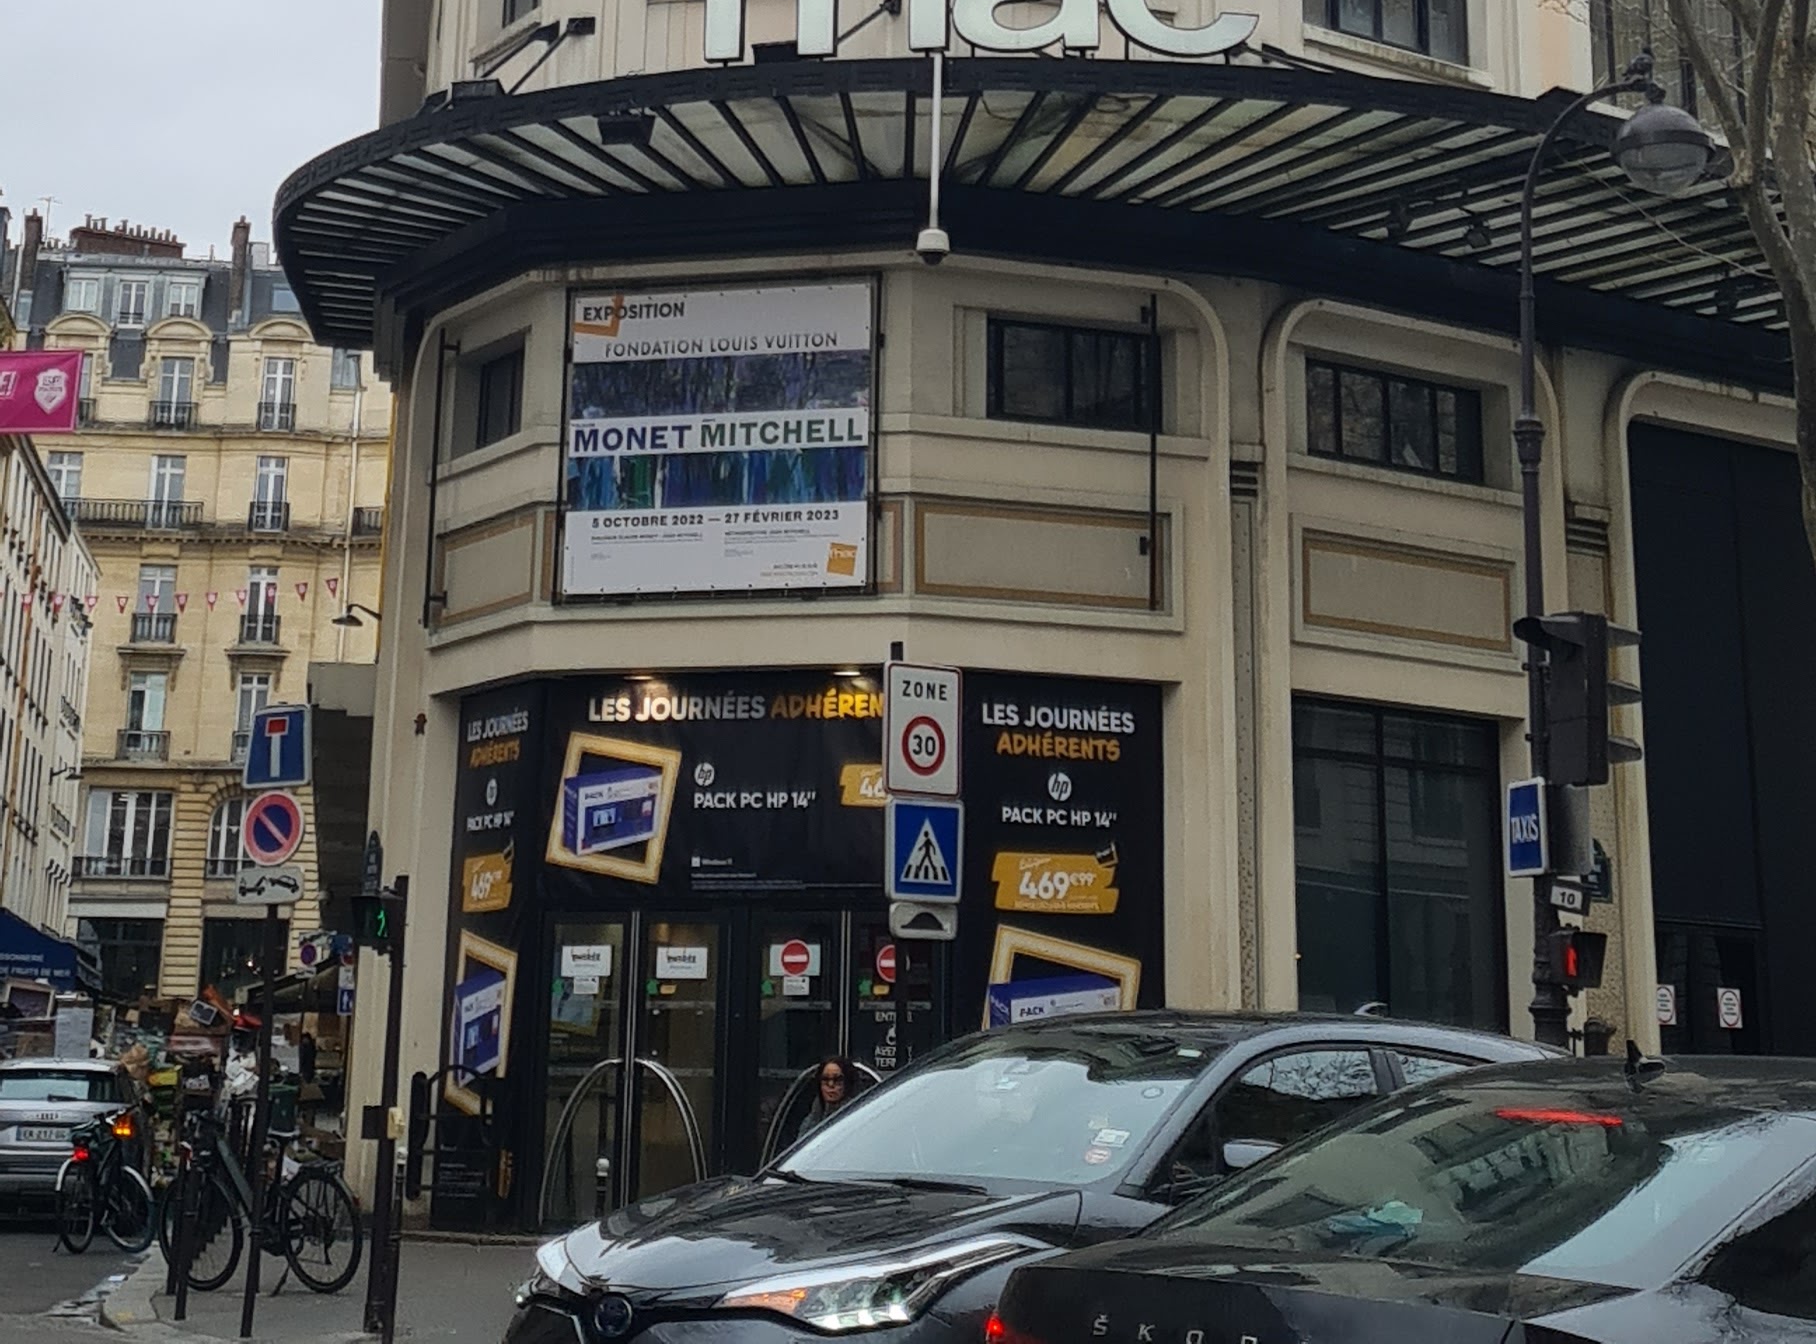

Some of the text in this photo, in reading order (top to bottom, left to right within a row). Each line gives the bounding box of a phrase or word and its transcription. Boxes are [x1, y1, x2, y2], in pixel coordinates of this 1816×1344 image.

[583, 301, 685, 322] EXPOSITION
[605, 331, 838, 358] FONDATION LOUIS VUITTON
[574, 417, 863, 453] MONET MITCHELL
[602, 515, 668, 528] OCTOBRE
[671, 514, 704, 526] 2022
[724, 512, 740, 524] 27
[743, 509, 803, 523] FÉVRIER
[806, 509, 840, 521] 2023
[902, 680, 948, 702] ZONE
[588, 687, 886, 723] LES JOURNÉES ADHÉREN
[982, 702, 1136, 734] LES JOURNÉES
[911, 734, 937, 757] 30
[996, 731, 1121, 762] ADHÉRENTS
[1048, 772, 1072, 802] hp
[693, 791, 737, 809] PACK
[740, 791, 764, 809] PC
[766, 791, 789, 809] HP
[1001, 806, 1044, 825] PACK
[1046, 809, 1068, 826] PC
[1070, 810, 1092, 827] HP
[1510, 813, 1539, 844] TAXIS
[1559, 890, 1576, 906] 10
